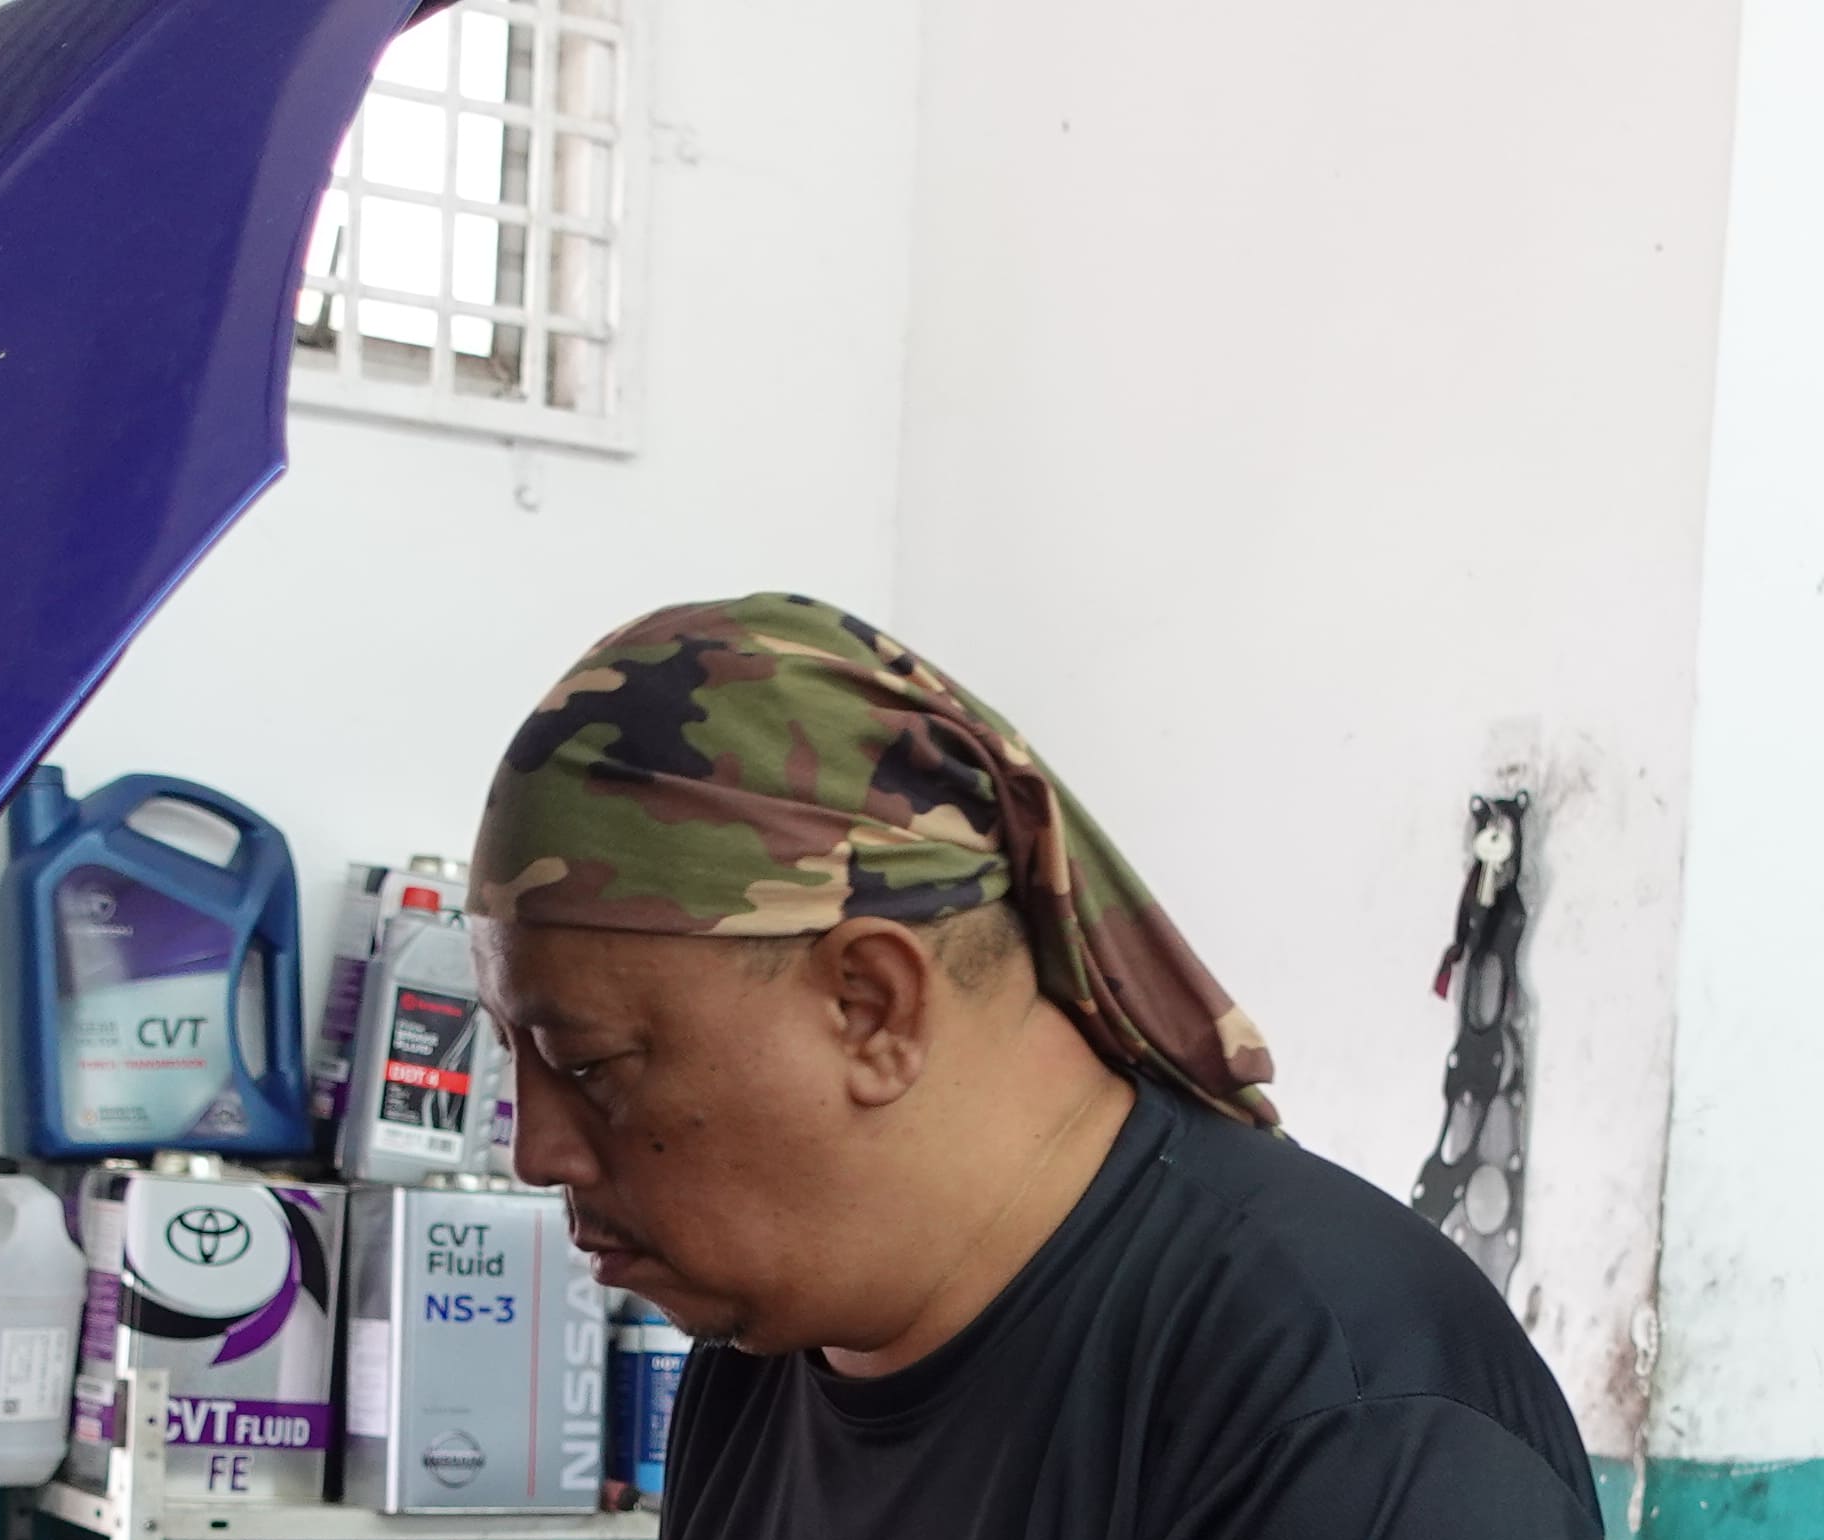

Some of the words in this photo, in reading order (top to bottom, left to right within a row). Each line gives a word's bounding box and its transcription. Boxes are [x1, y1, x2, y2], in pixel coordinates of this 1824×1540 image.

[138, 1017, 208, 1048] CVT
[428, 1222, 491, 1247] CVT
[428, 1252, 506, 1278] Fluid
[426, 1295, 517, 1323] NS-3
[234, 1413, 311, 1447] FLUID
[209, 1454, 251, 1493] FE
